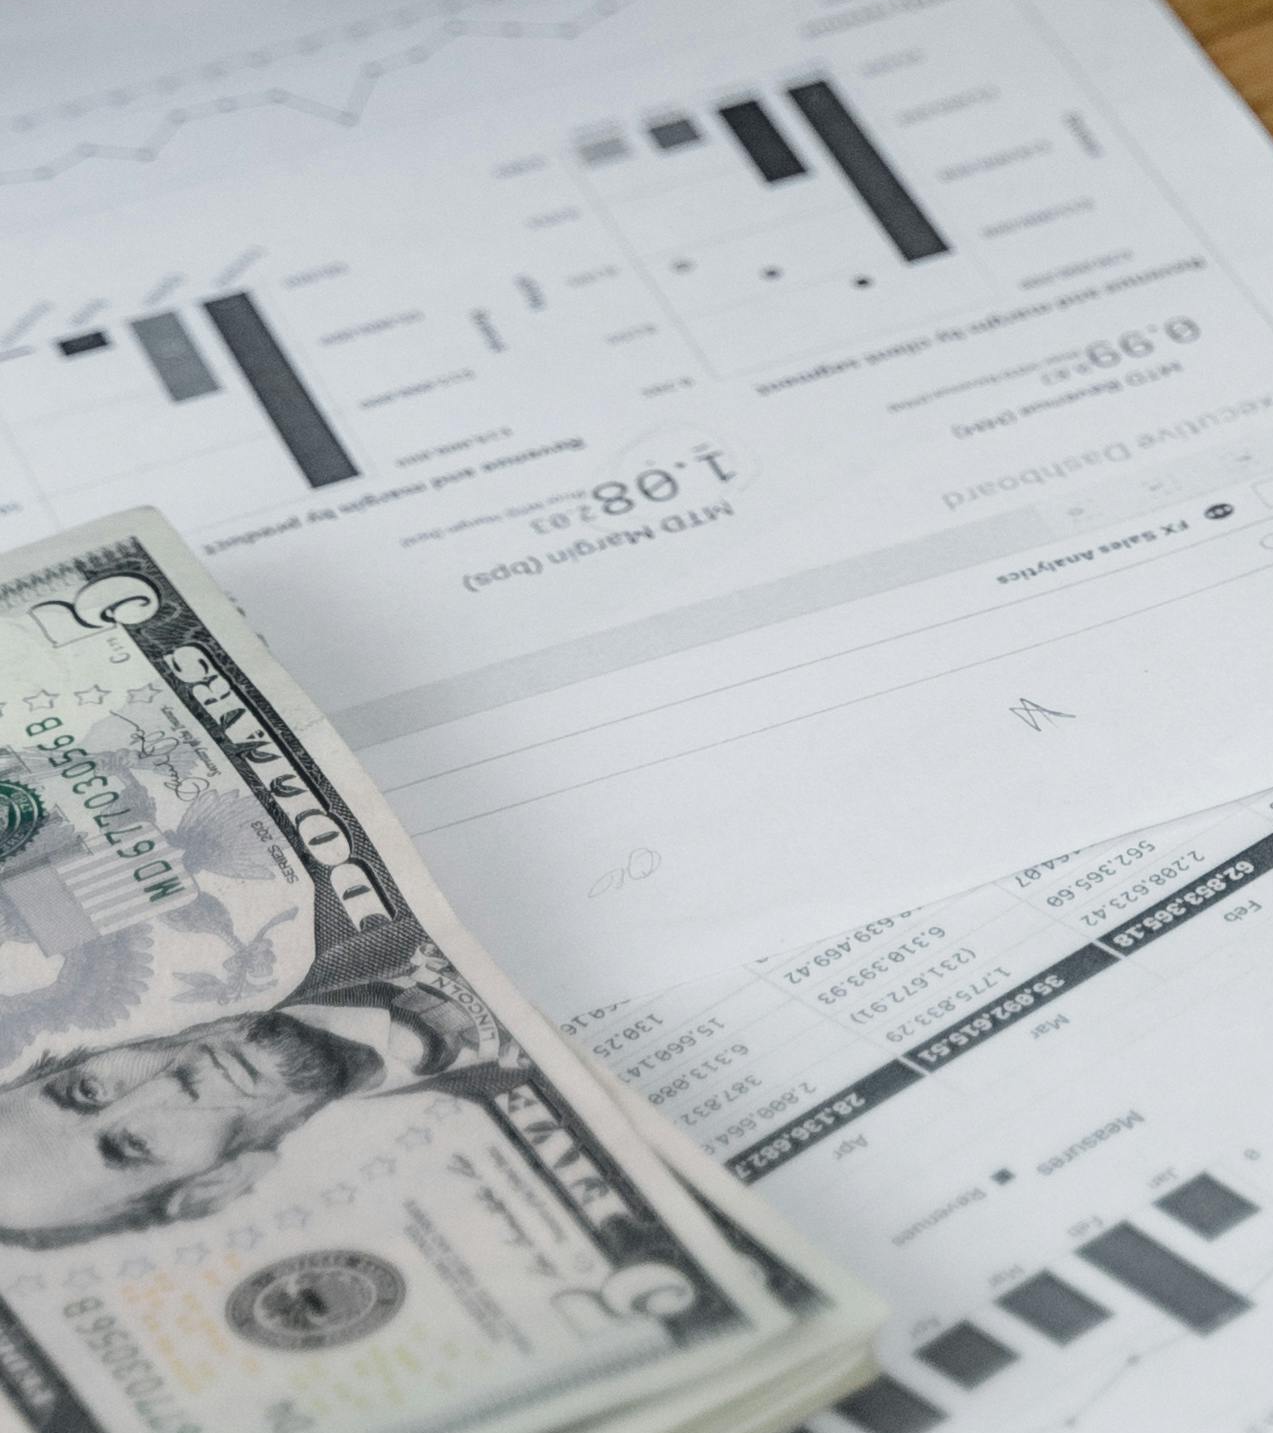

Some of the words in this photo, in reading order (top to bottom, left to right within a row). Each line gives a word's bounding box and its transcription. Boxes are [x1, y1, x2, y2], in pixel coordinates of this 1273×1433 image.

[591, 451, 736, 516] 1.08
[941, 441, 1132, 512] Dashboard
[546, 525, 656, 565] Margin
[660, 501, 735, 534] MTD
[1097, 530, 1158, 554] Sales
[1161, 520, 1189, 536] FX
[462, 555, 544, 593] (bps)
[996, 549, 1095, 585] Analytics
[28, 572, 162, 649] 5
[157, 636, 397, 936] DOLLARS
[250, 820, 274, 843] 2013
[266, 843, 298, 884] SERIES
[1045, 840, 1156, 908] 562,365.60
[1080, 850, 1206, 927] 2,208,623.42
[1113, 860, 1255, 955] 62,853,365.18
[1223, 899, 1263, 923] Feb
[816, 926, 946, 1005] 6,310,393.93
[849, 947, 977, 1025] (231,672.91)
[429, 973, 501, 1043] LINCOLN
[591, 1013, 663, 1059] 130.25
[885, 966, 1011, 1043] 1,775,833.29
[918, 974, 1065, 1063] 35,092,615.51
[1030, 1013, 1071, 1040] Mar
[494, 1081, 636, 1234] FIVE
[833, 1133, 869, 1161] Apr
[1036, 1109, 1145, 1176] Measures
[889, 1188, 986, 1249] Revenues
[546, 1260, 700, 1348] 5
